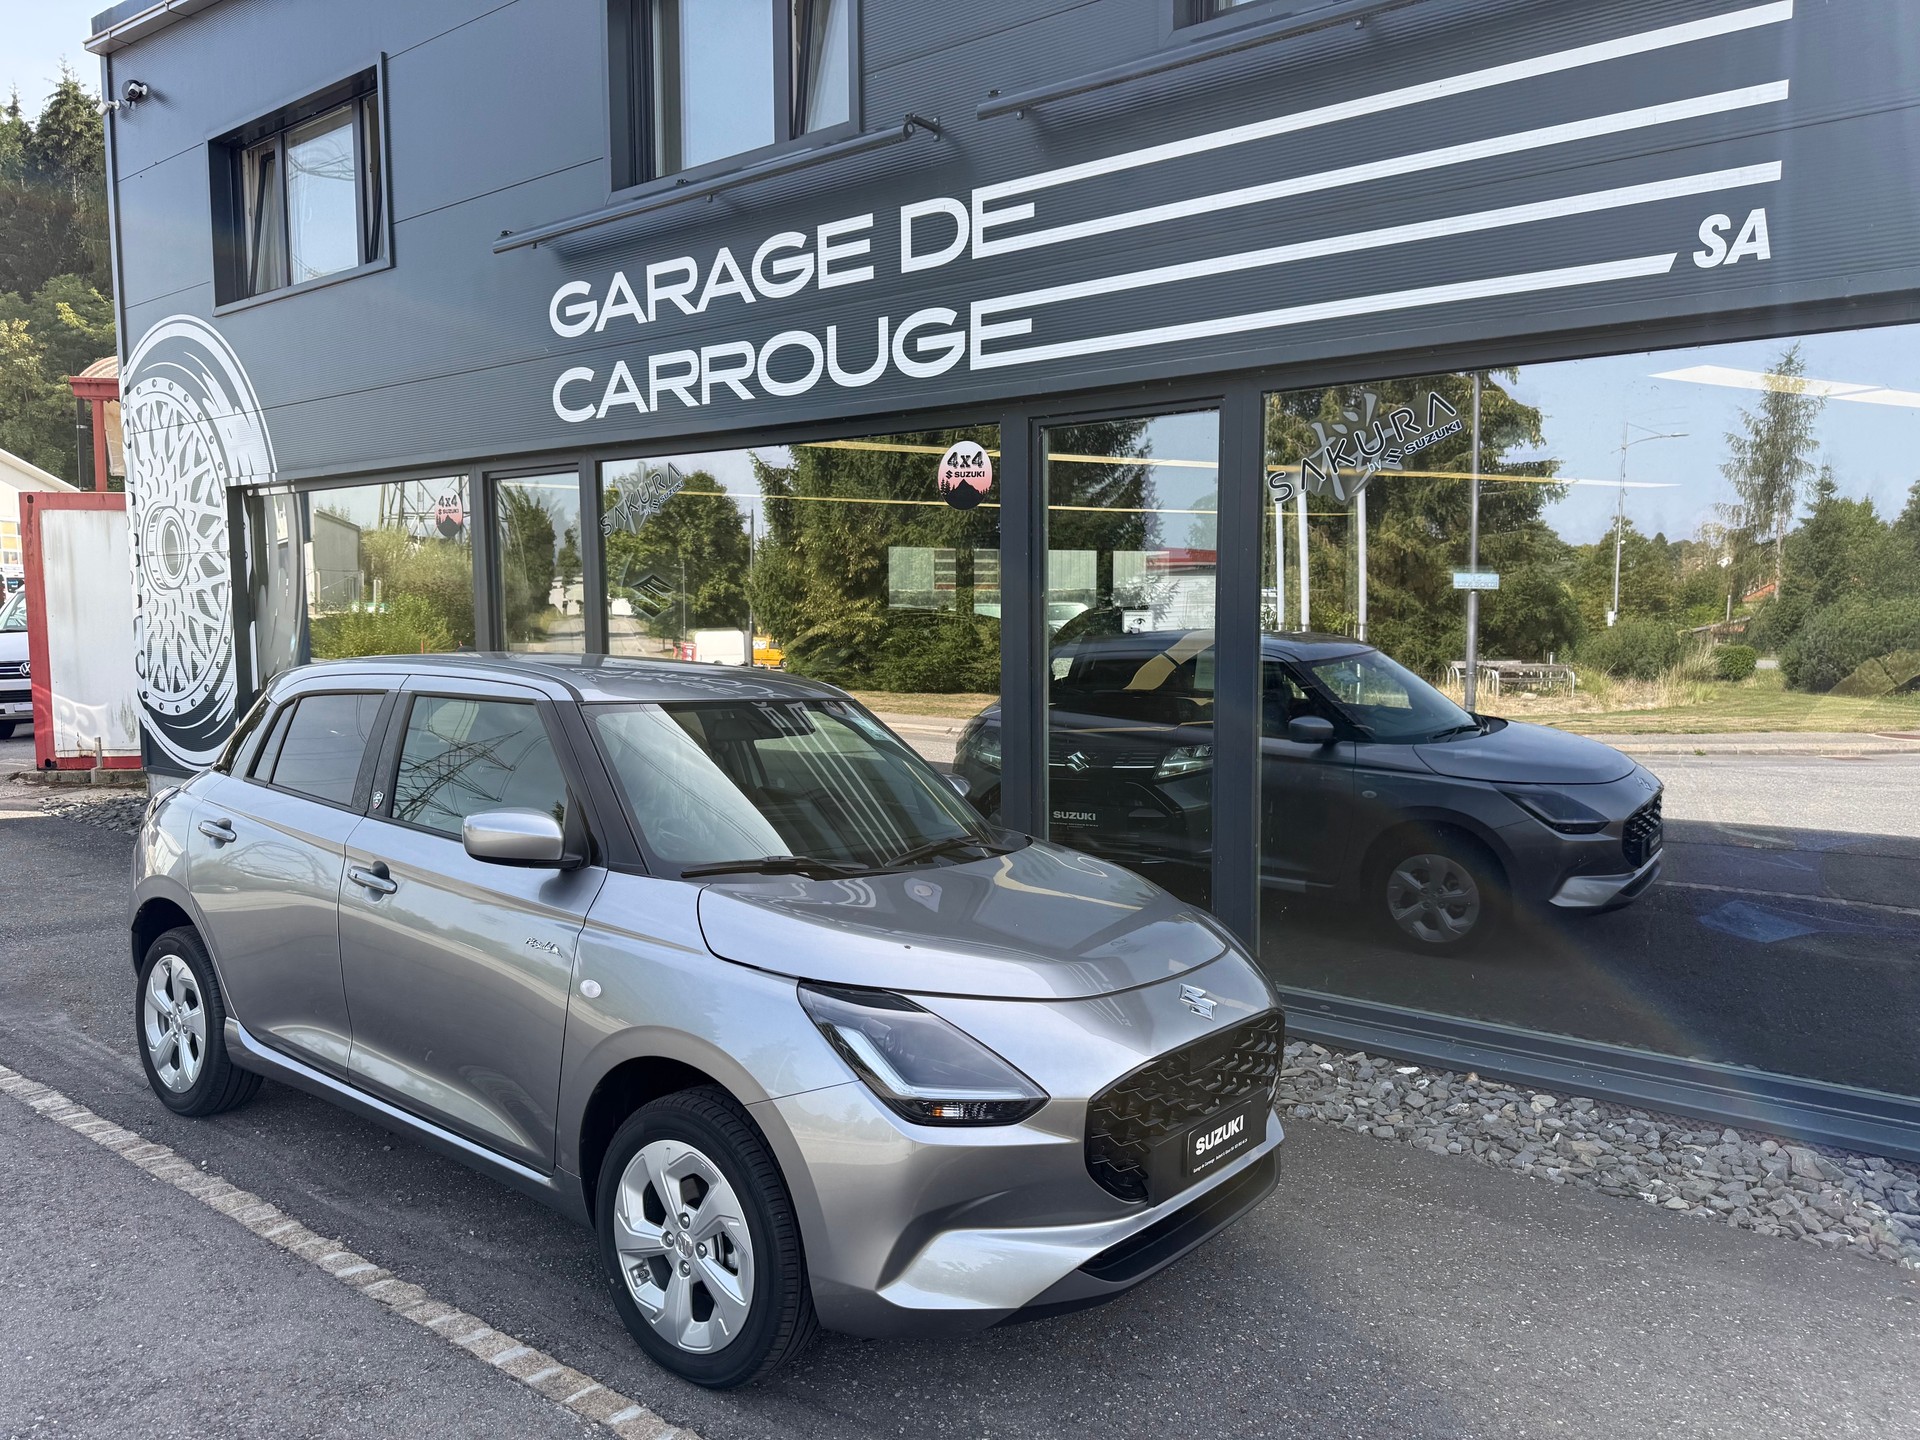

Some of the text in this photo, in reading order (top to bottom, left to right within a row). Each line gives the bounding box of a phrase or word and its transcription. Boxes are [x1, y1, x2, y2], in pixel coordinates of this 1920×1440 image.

[549, 184, 1036, 338] GARAGE DE
[1693, 207, 1771, 269] SA
[552, 294, 1034, 423] CARROUGE
[947, 450, 985, 469] 4x4
[954, 470, 985, 478] SUZUKI
[1268, 391, 1457, 504] SAKURA
[1367, 418, 1463, 473] by SUZUKI
[600, 462, 683, 537] SAKURA
[1053, 810, 1096, 821] SUZUKI
[1195, 1114, 1245, 1156] SUZUKI
